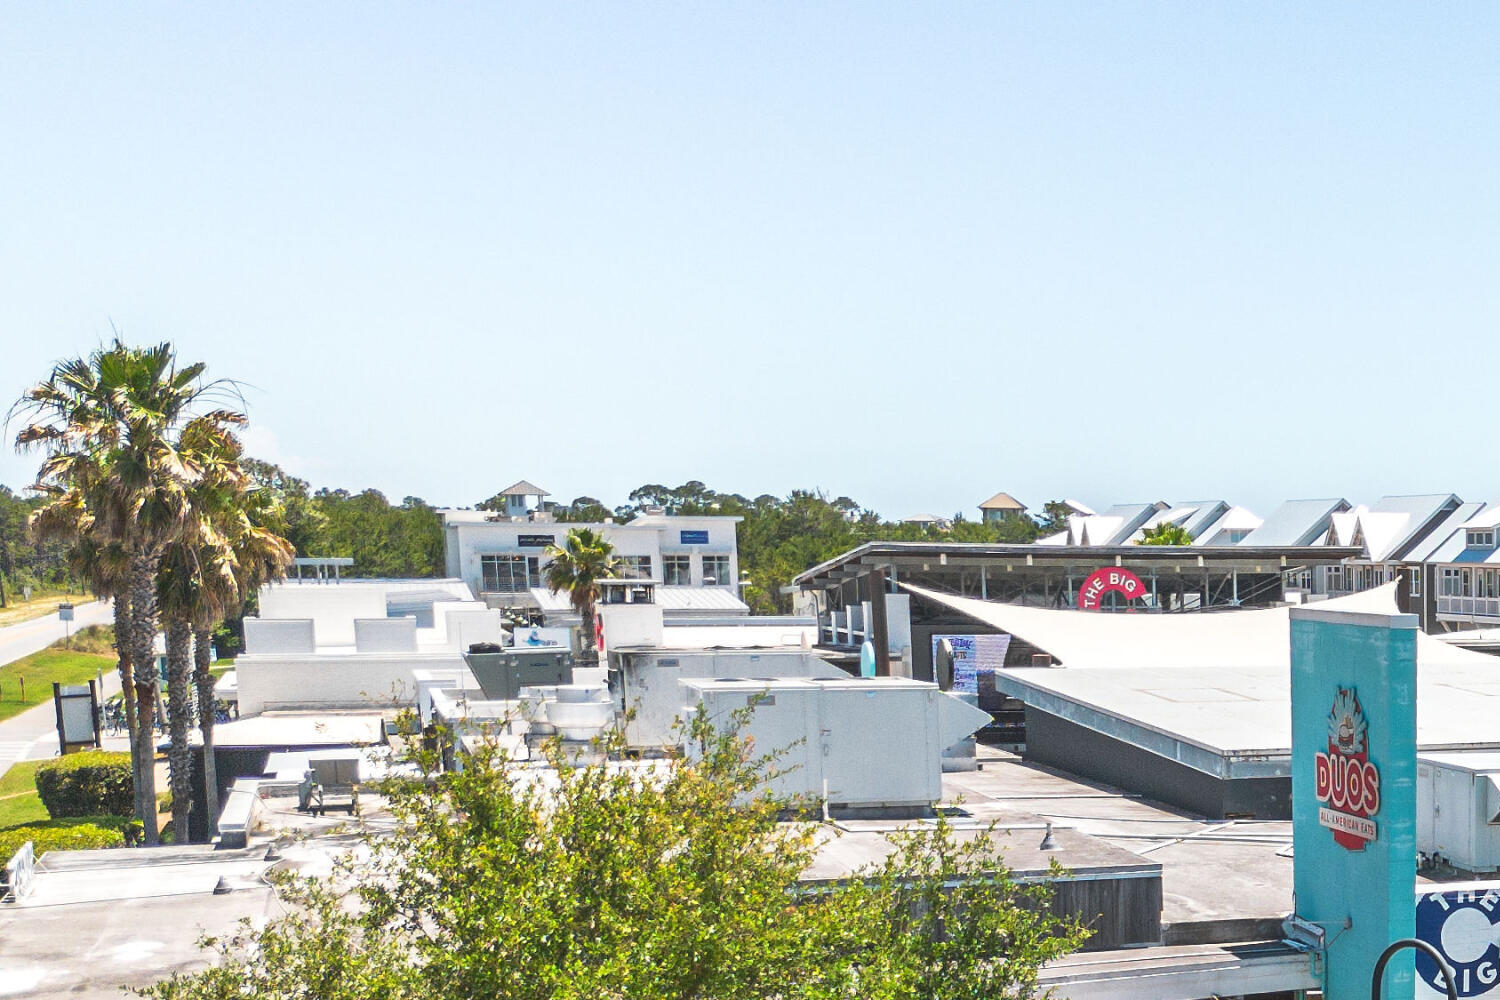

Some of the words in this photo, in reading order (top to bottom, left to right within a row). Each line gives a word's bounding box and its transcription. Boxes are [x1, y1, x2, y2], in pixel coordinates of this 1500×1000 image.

[1084, 577, 1105, 608] THE
[1109, 572, 1136, 592] BIG
[1315, 752, 1379, 815] DUOS
[1320, 811, 1359, 831] ALL-AMERICAN
[1360, 822, 1374, 835] EATS
[1433, 961, 1498, 993] BIG
